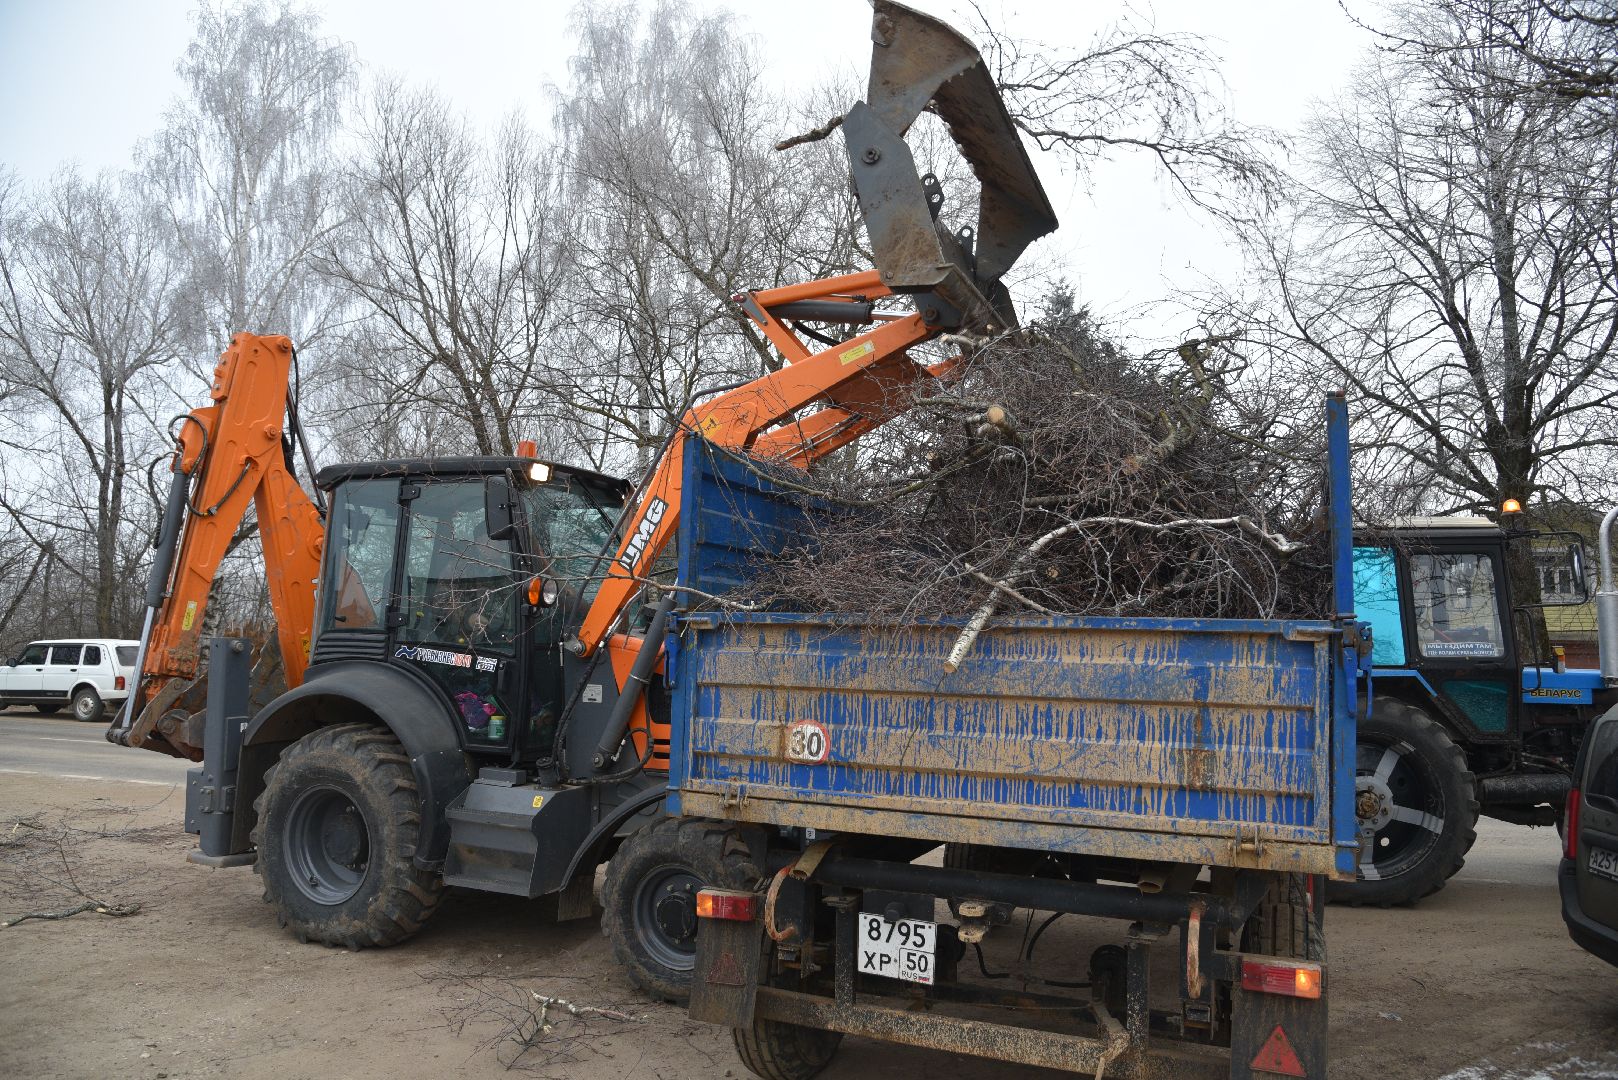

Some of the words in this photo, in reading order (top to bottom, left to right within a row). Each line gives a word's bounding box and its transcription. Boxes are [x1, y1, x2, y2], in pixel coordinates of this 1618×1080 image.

[619, 498, 666, 570] UMG
[792, 730, 822, 757] 30
[867, 917, 926, 948] 8795
[863, 950, 892, 972] ХР
[906, 951, 928, 973] 50
[901, 970, 918, 980] RUS
